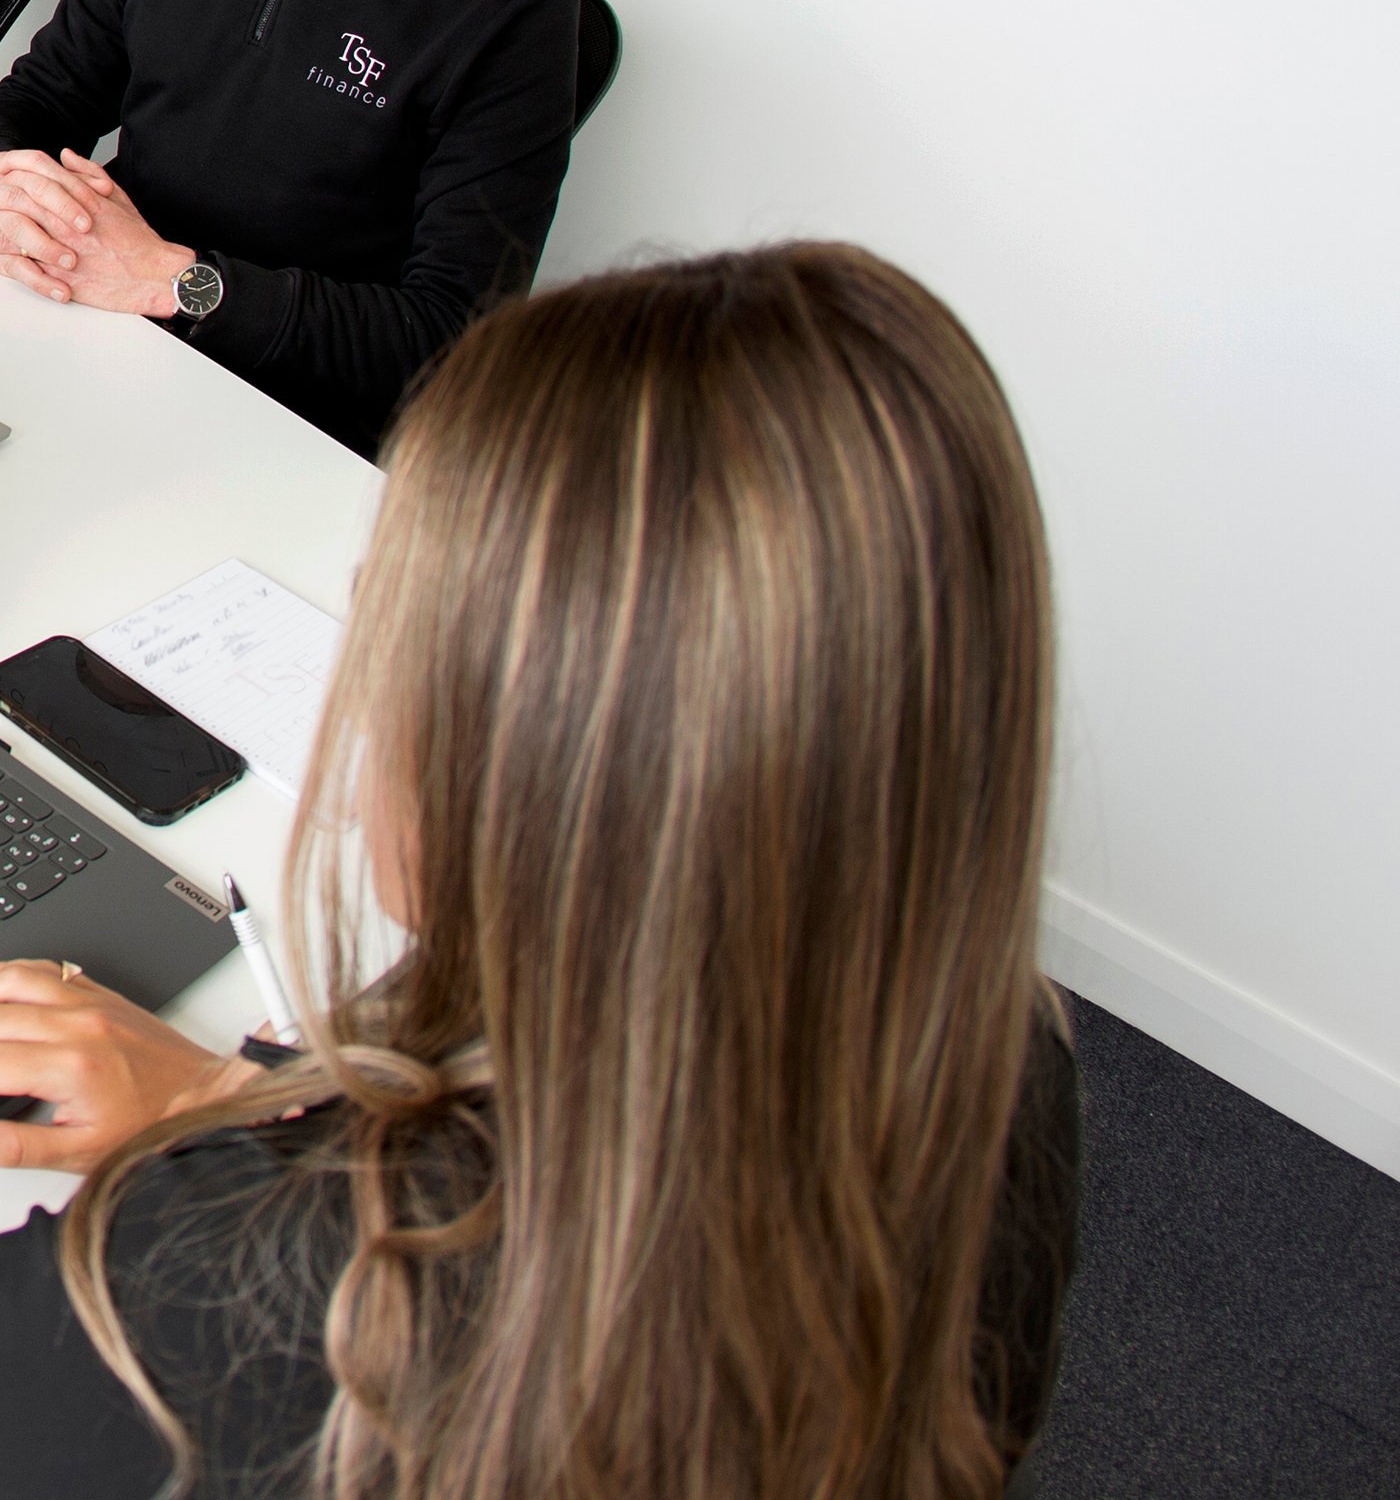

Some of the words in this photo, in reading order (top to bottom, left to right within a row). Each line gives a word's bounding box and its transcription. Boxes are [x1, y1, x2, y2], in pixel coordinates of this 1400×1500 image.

[338, 32, 386, 88] TSF
[306, 66, 387, 109] finance
[174, 879, 223, 920] Lenovo
